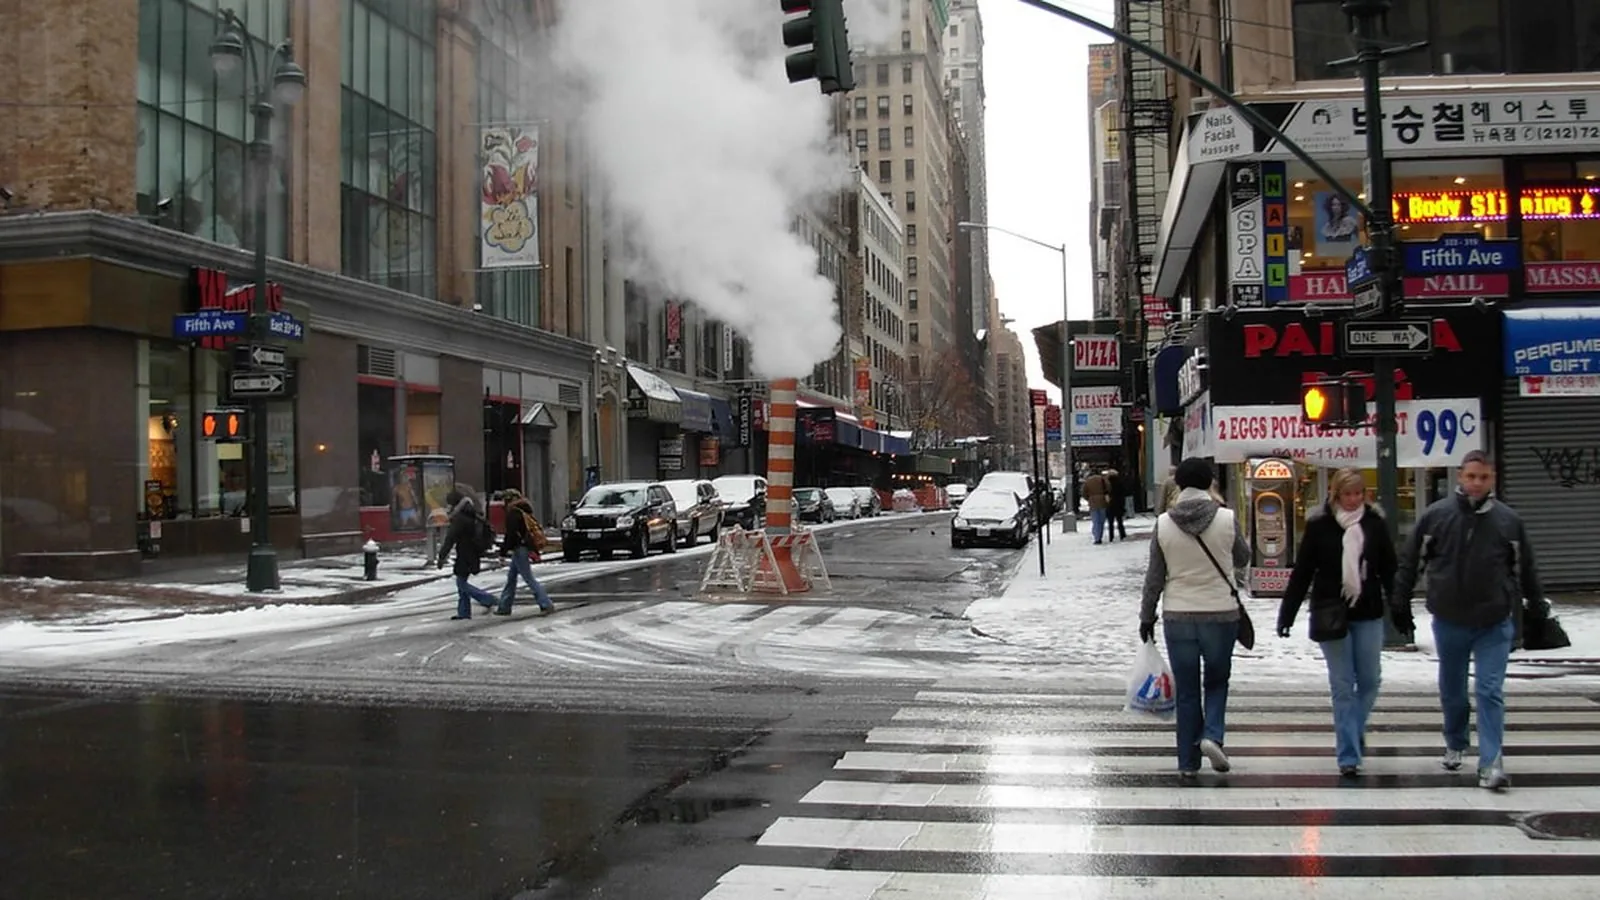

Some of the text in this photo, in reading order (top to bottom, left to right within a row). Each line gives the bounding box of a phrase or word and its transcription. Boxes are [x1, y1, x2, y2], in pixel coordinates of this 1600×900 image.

[1206, 115, 1233, 128] Nails
[1204, 130, 1236, 143] Facial
[1201, 143, 1241, 155] Massage
[1409, 194, 1461, 218] Body
[1268, 180, 1283, 283] NAIL
[1235, 210, 1262, 279] SPA
[1422, 250, 1502, 267] Fifth Ave
[1424, 275, 1483, 291] NAIL
[185, 317, 236, 332] Fifth Ave
[1353, 331, 1418, 343] ONE WAY
[1076, 341, 1118, 366] PIZZA
[1551, 358, 1591, 372] GIFT
[1218, 420, 1226, 440] 2
[1230, 416, 1267, 439] EGGS
[1258, 468, 1288, 476] ATM
